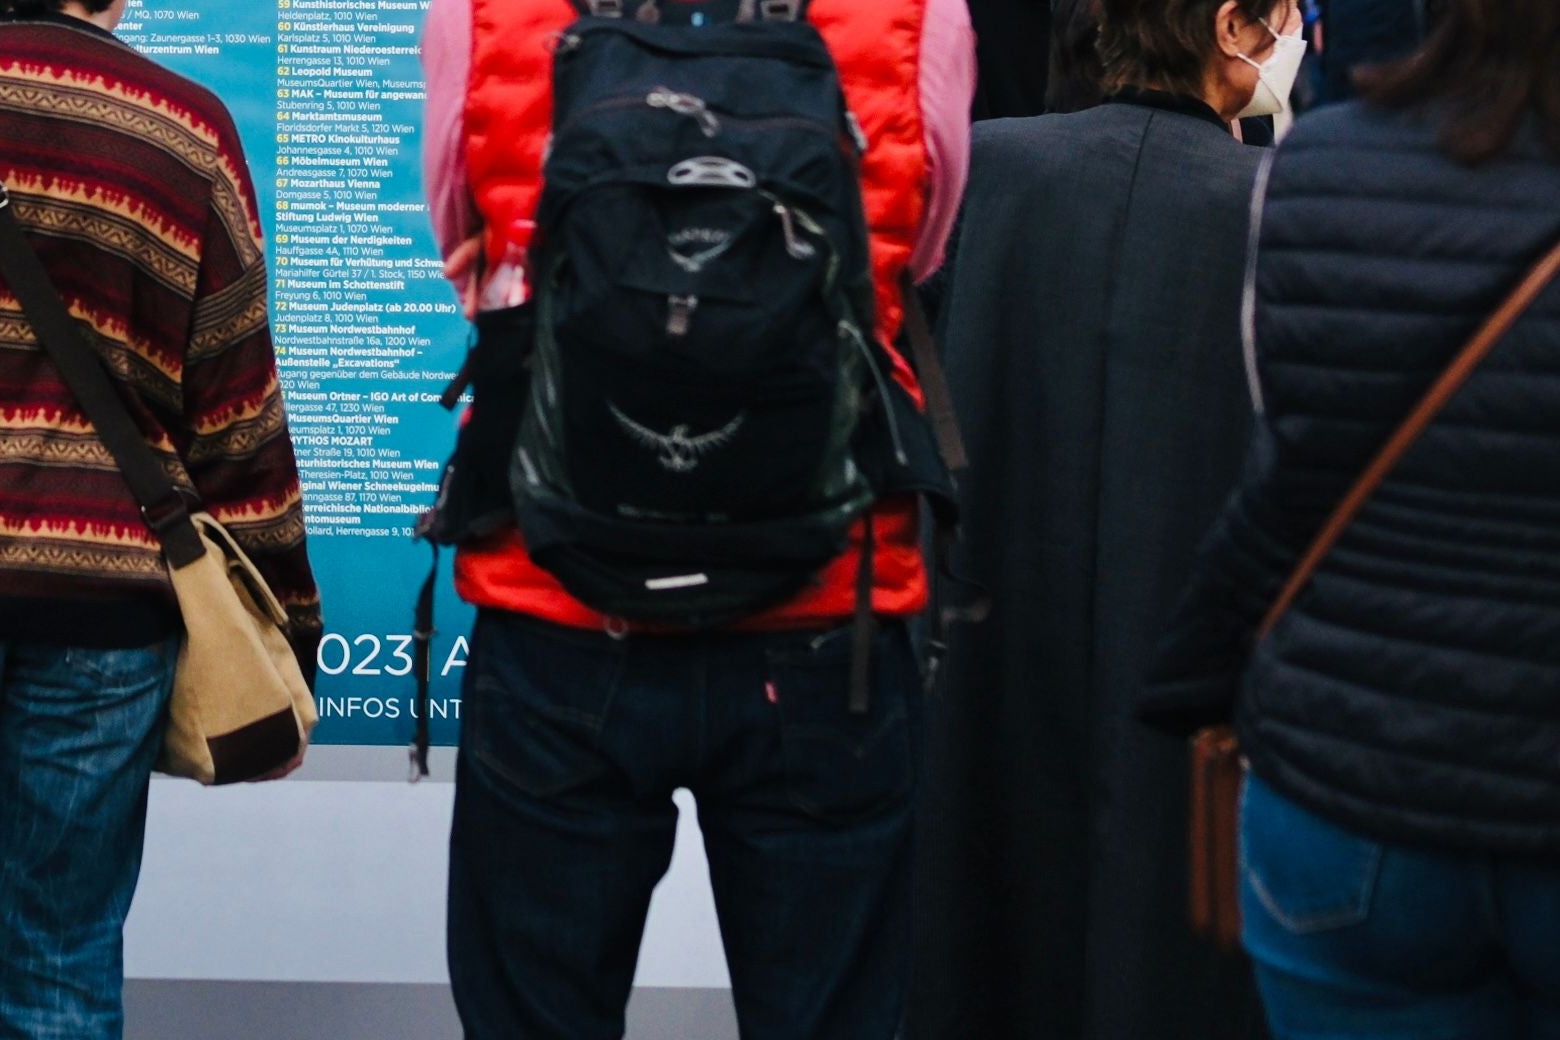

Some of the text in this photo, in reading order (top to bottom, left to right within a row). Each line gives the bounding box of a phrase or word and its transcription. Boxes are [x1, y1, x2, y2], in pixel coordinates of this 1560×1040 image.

[278, 22, 414, 34] 60 Künstlerhaus Vereinigung
[277, 66, 373, 78] 62 Leopold Museum
[277, 112, 382, 121] 64 Marktamtsmuseum
[276, 134, 399, 144] 65 METRO Kinokulturhaus
[276, 156, 387, 166] 66 Möbelmuseum Wien
[276, 178, 380, 188] 67 Mozarthaus Vienna
[276, 234, 412, 247] 69 Museum der Nerdigkeiten
[275, 279, 405, 289] 71 Museum im Schottenstift
[274, 324, 415, 334] 73 Museum Nordwestbahnhof
[331, 436, 373, 445] MOZART
[319, 697, 400, 719] INFOS
